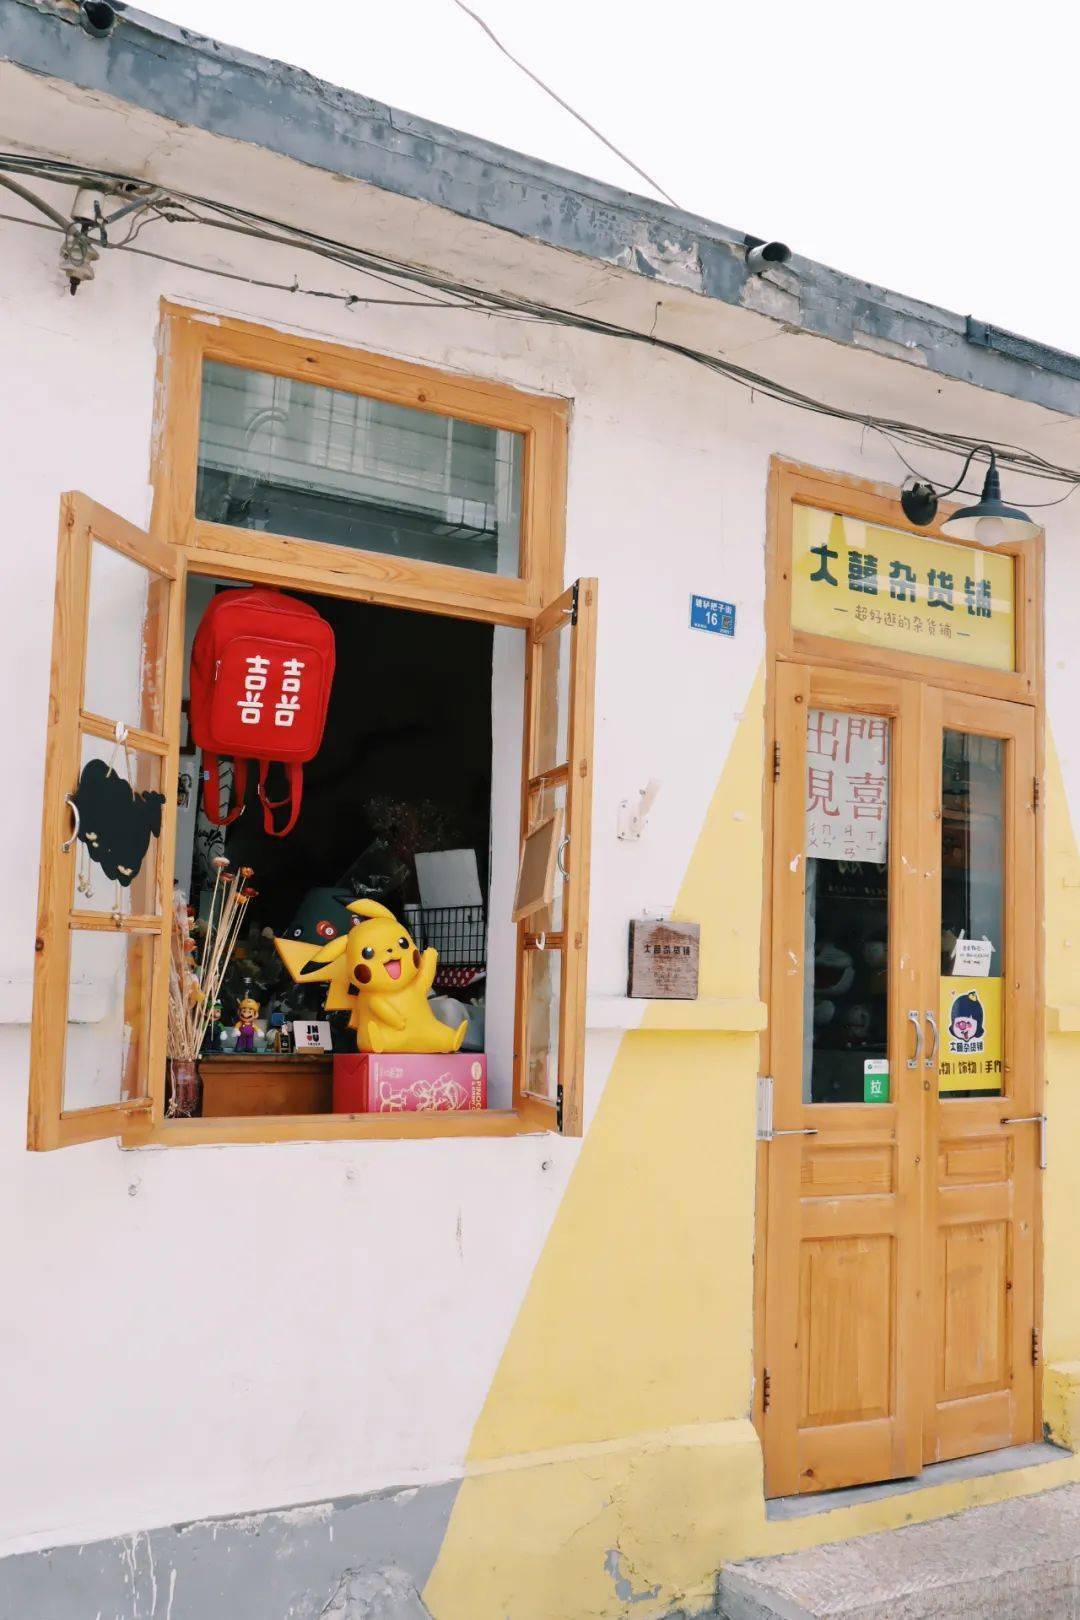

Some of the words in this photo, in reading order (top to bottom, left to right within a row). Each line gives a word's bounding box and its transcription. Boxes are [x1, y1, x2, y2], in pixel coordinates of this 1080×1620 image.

[809, 543, 992, 618] 大囍杂货铺
[705, 611, 718, 626] 16
[806, 766, 887, 821] 見喜
